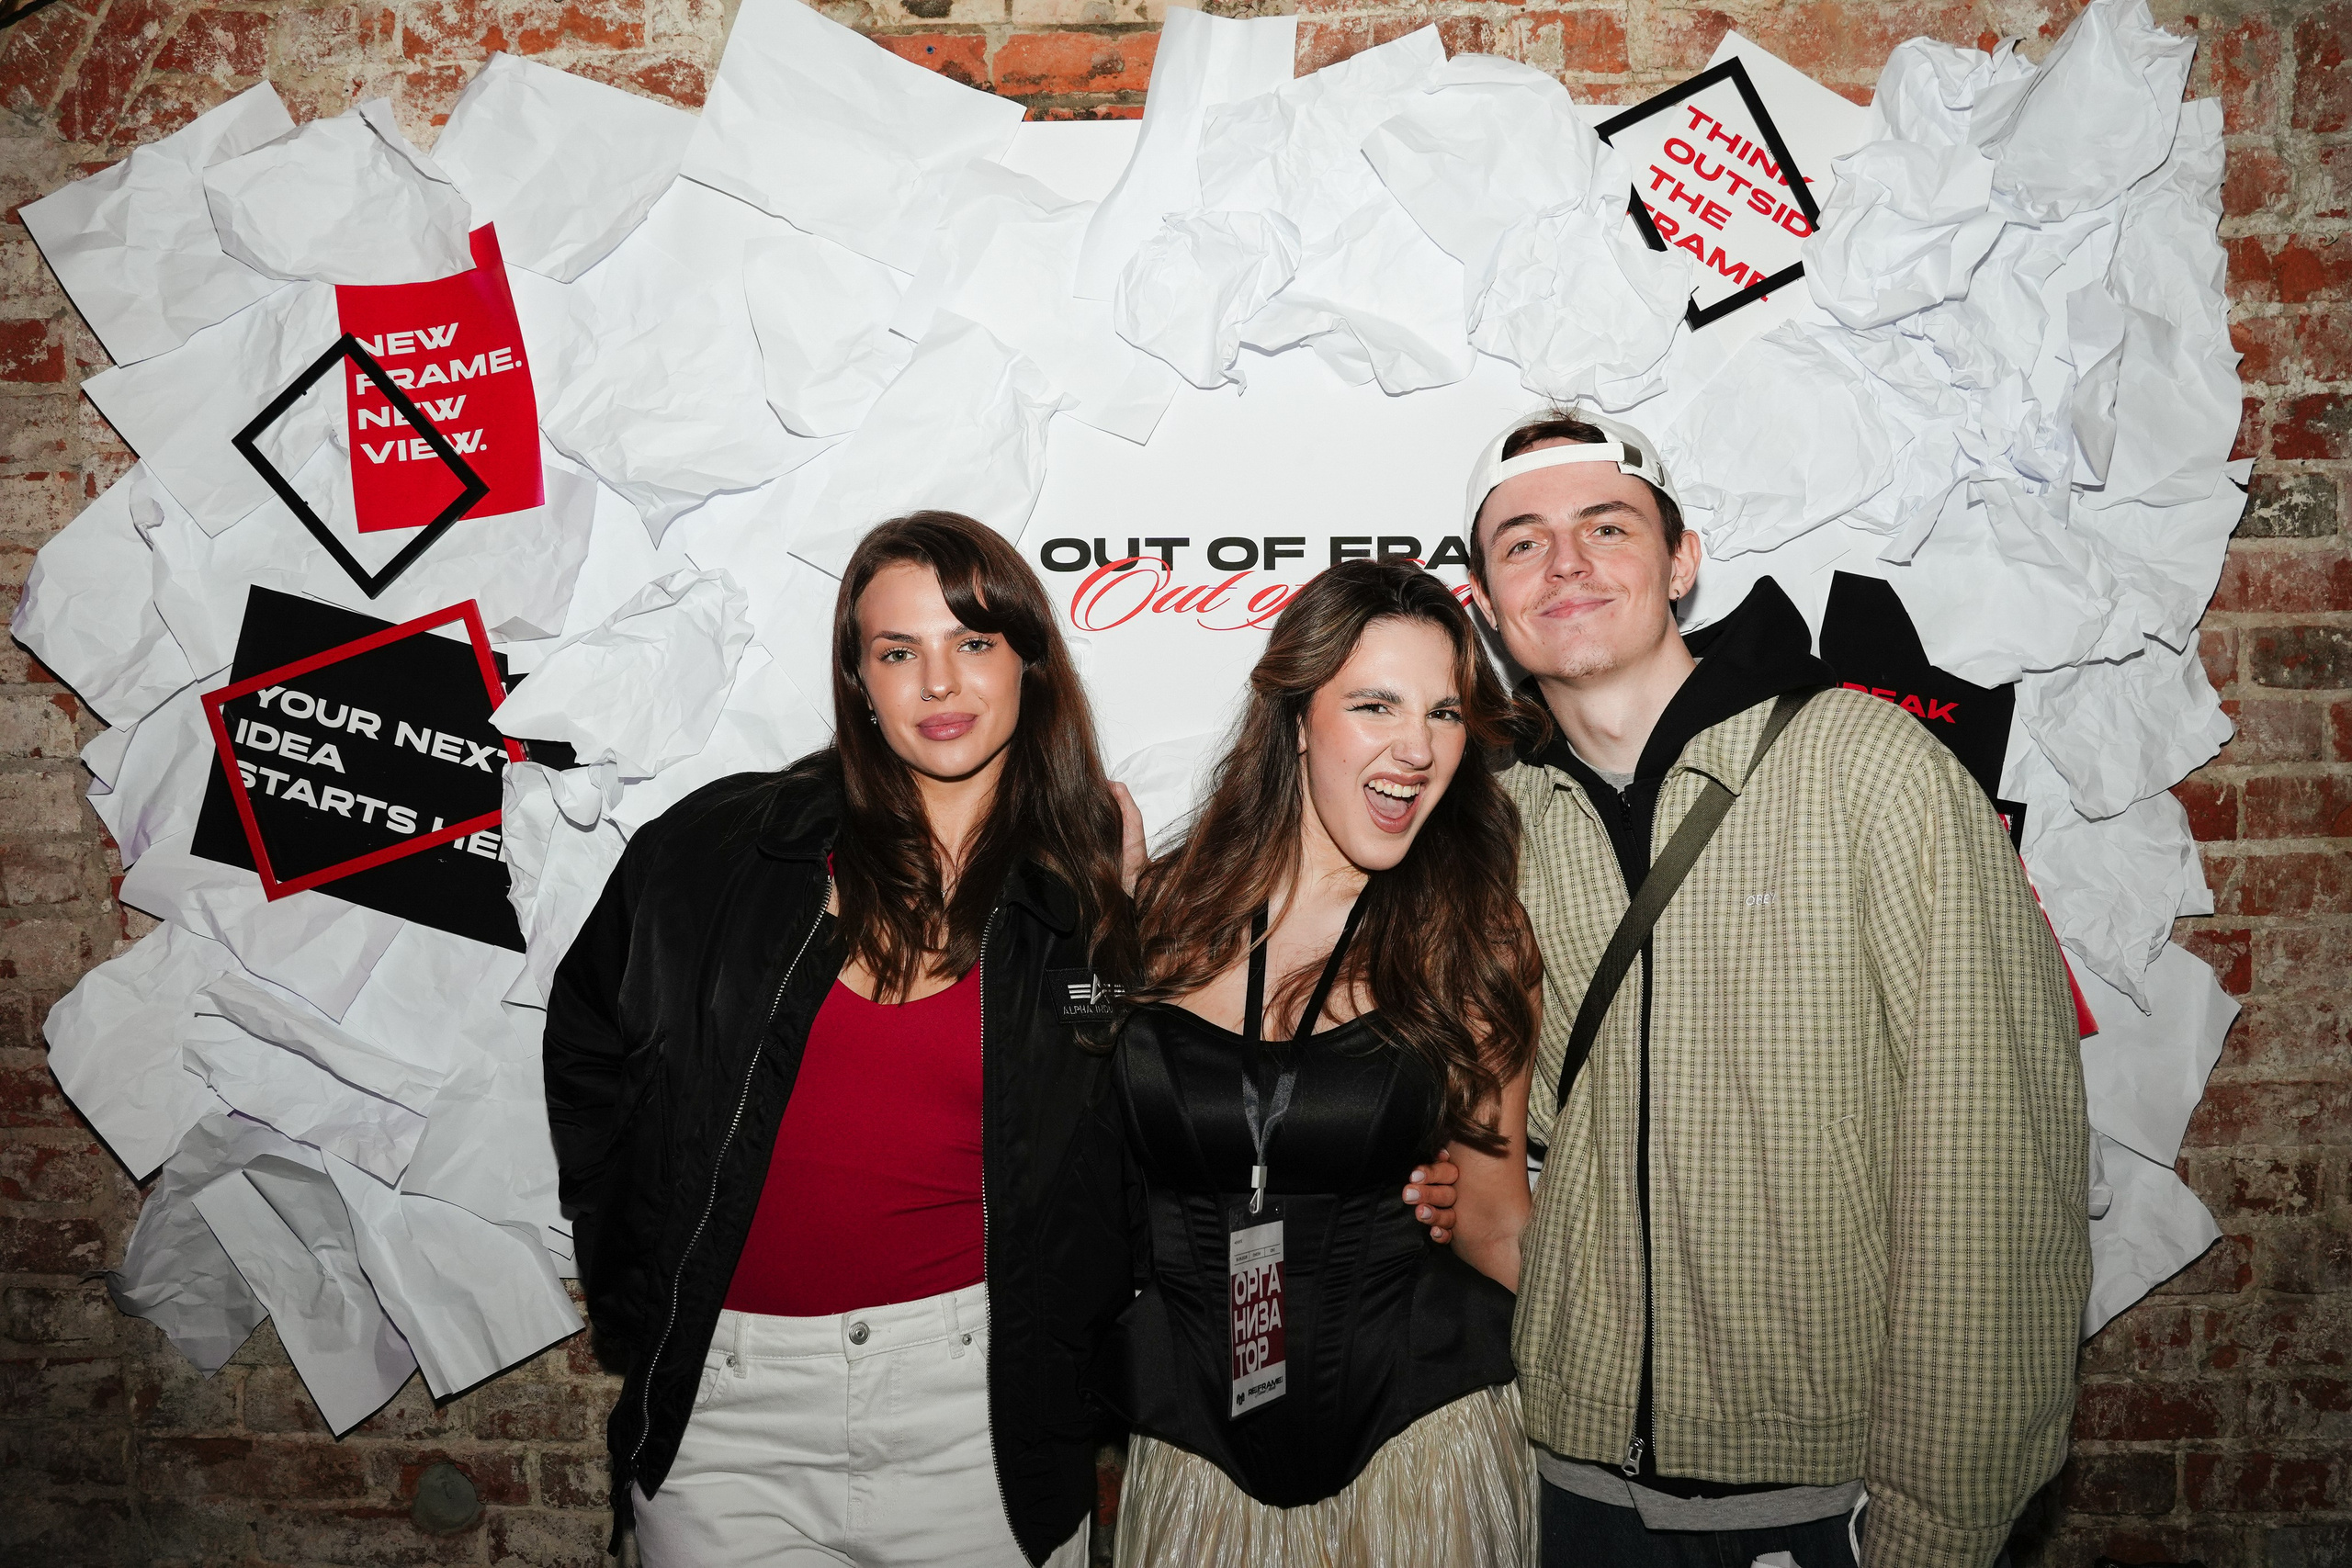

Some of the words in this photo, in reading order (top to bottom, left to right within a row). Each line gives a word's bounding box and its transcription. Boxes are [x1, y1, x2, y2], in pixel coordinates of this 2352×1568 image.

[1649, 164, 1733, 231] THE
[1040, 536, 1190, 572] OUT
[1207, 536, 1306, 572] OF
[1070, 556, 1255, 632] Out
[257, 686, 381, 740] YOUR
[235, 718, 345, 773] IDEA
[238, 761, 417, 835] STARTS
[1746, 892, 1776, 906] OBEY
[1063, 1005, 1093, 1015] ALPHA
[1234, 1262, 1282, 1305] ОРГА
[1233, 1298, 1283, 1344] НИЗА
[1236, 1336, 1270, 1377] ТОР
